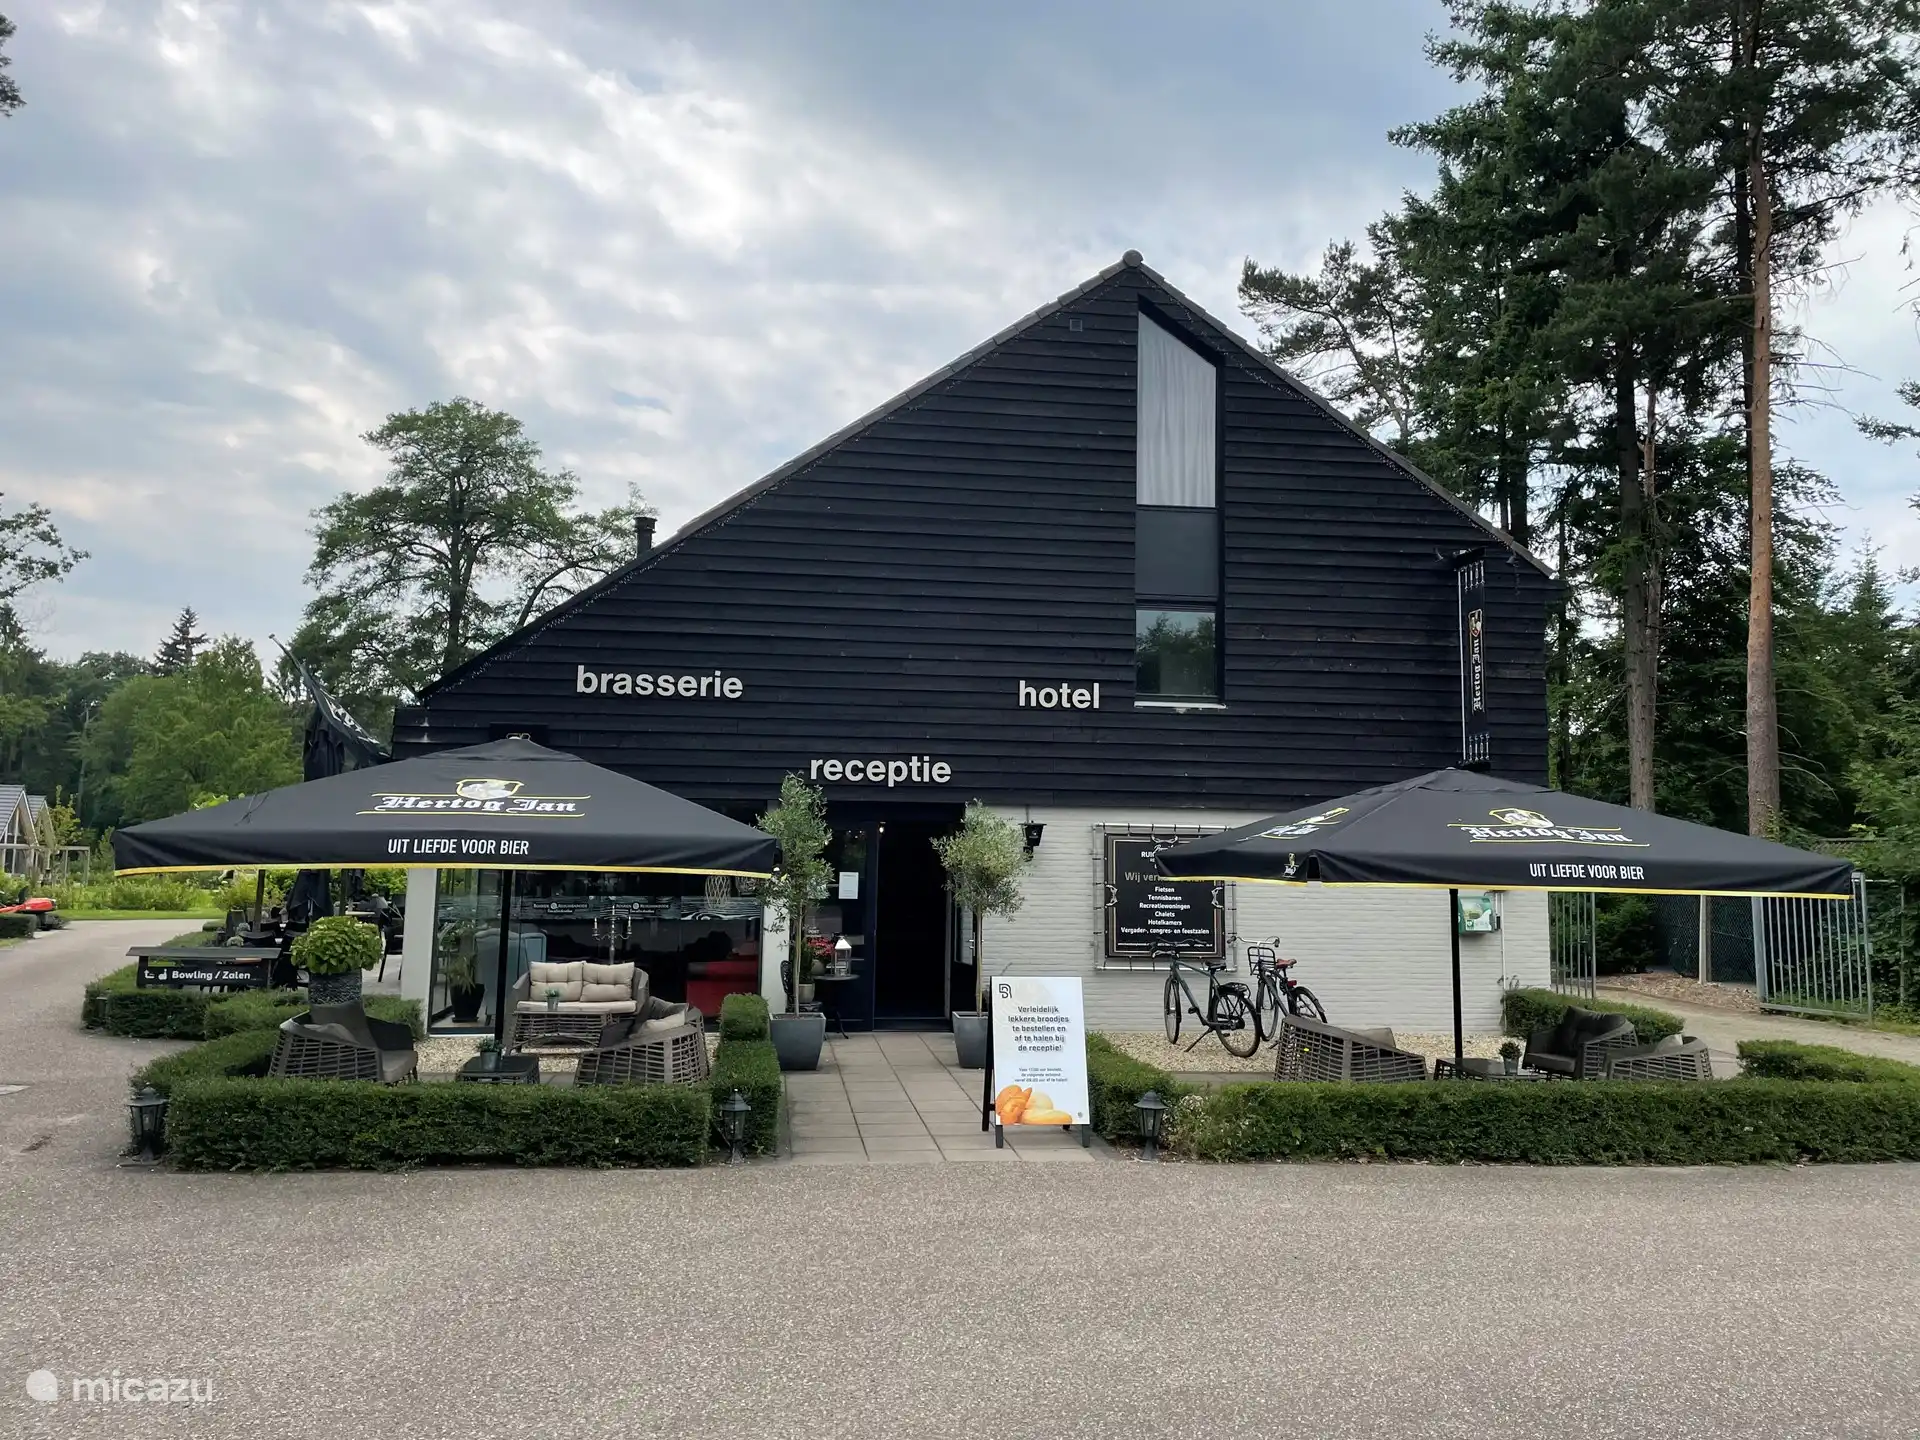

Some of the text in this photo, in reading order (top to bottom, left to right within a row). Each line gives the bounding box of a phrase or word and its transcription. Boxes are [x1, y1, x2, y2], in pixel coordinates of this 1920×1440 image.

[576, 665, 743, 699] brasserie
[1472, 638, 1483, 711] Hertog Jan
[1018, 680, 1100, 709] hotel
[810, 755, 952, 787] receptie
[374, 796, 577, 813] Hertog Jan
[1461, 826, 1633, 843] Hertog Jan
[387, 838, 530, 855] UIT LIEFDE VOOR BIER
[1124, 871, 1140, 883] Wij
[1529, 863, 1645, 880] UIT LIEFDE VOOR BIER
[1139, 902, 1191, 911] Recreatiewoningen
[1181, 927, 1210, 935] feestzalen
[171, 970, 251, 980] Bowling / Zalen
[1017, 1005, 1059, 1014] Verleidelijk
[1008, 1015, 1069, 1023] lekkere broodjes
[1029, 1044, 1062, 1052] receptie!
